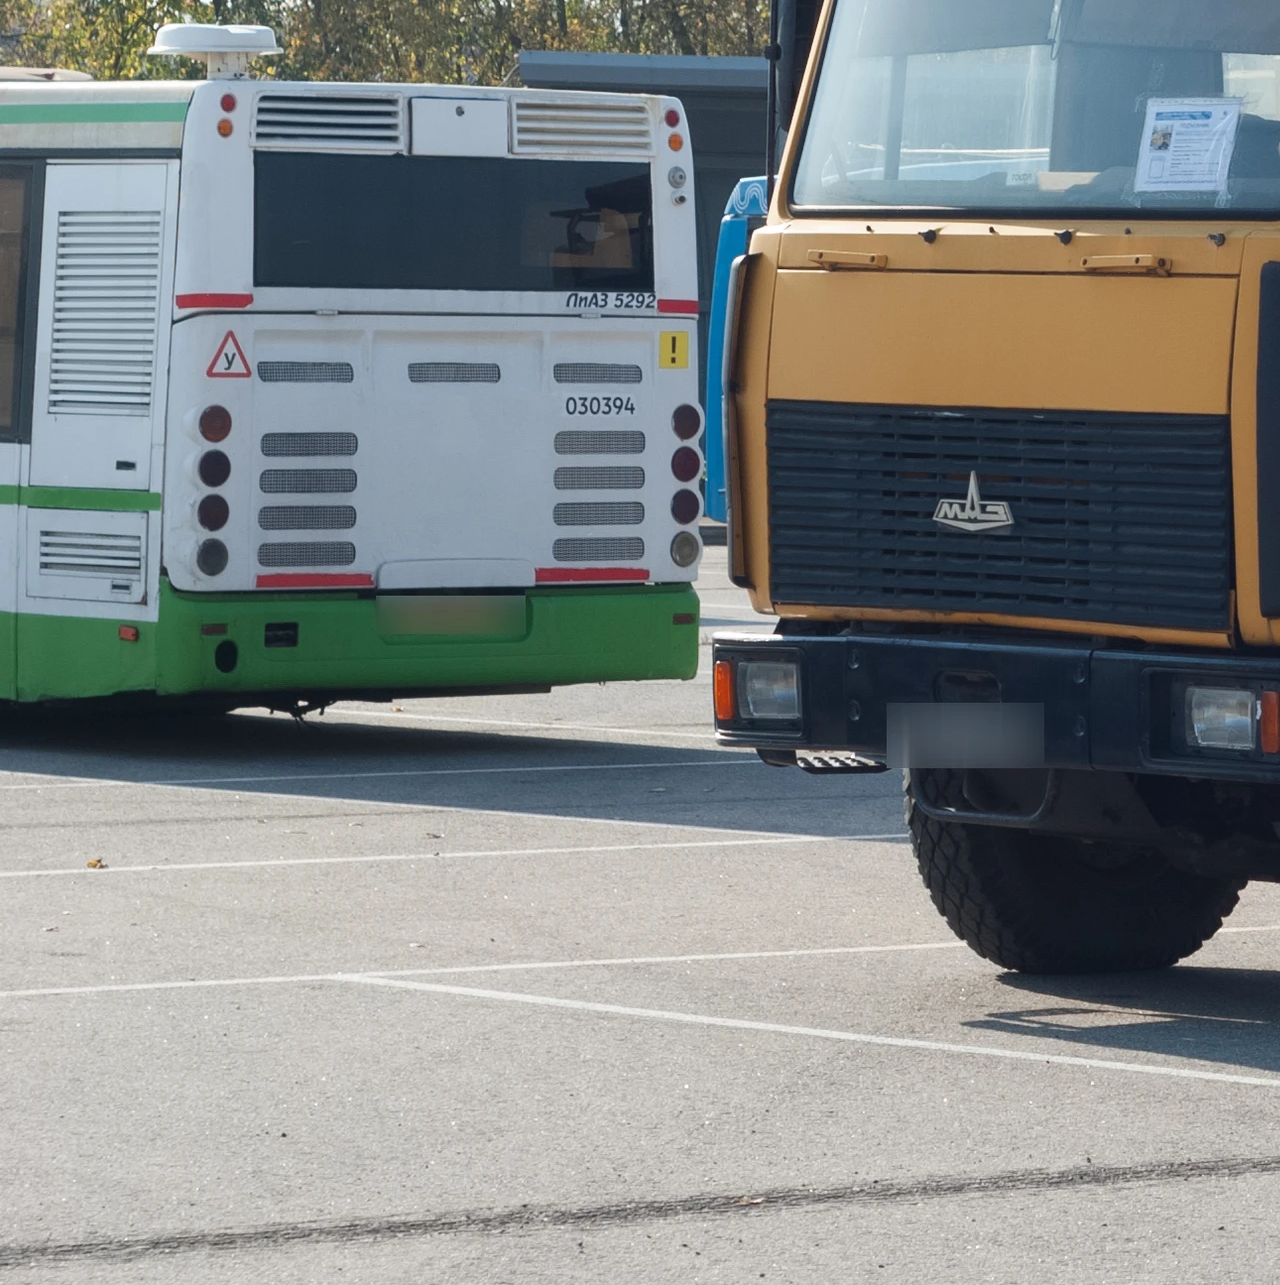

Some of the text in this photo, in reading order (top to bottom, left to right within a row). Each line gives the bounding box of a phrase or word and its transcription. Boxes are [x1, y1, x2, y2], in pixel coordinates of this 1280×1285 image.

[566, 292, 657, 309] ЛиАЗ 5292
[565, 396, 636, 415] 030394
